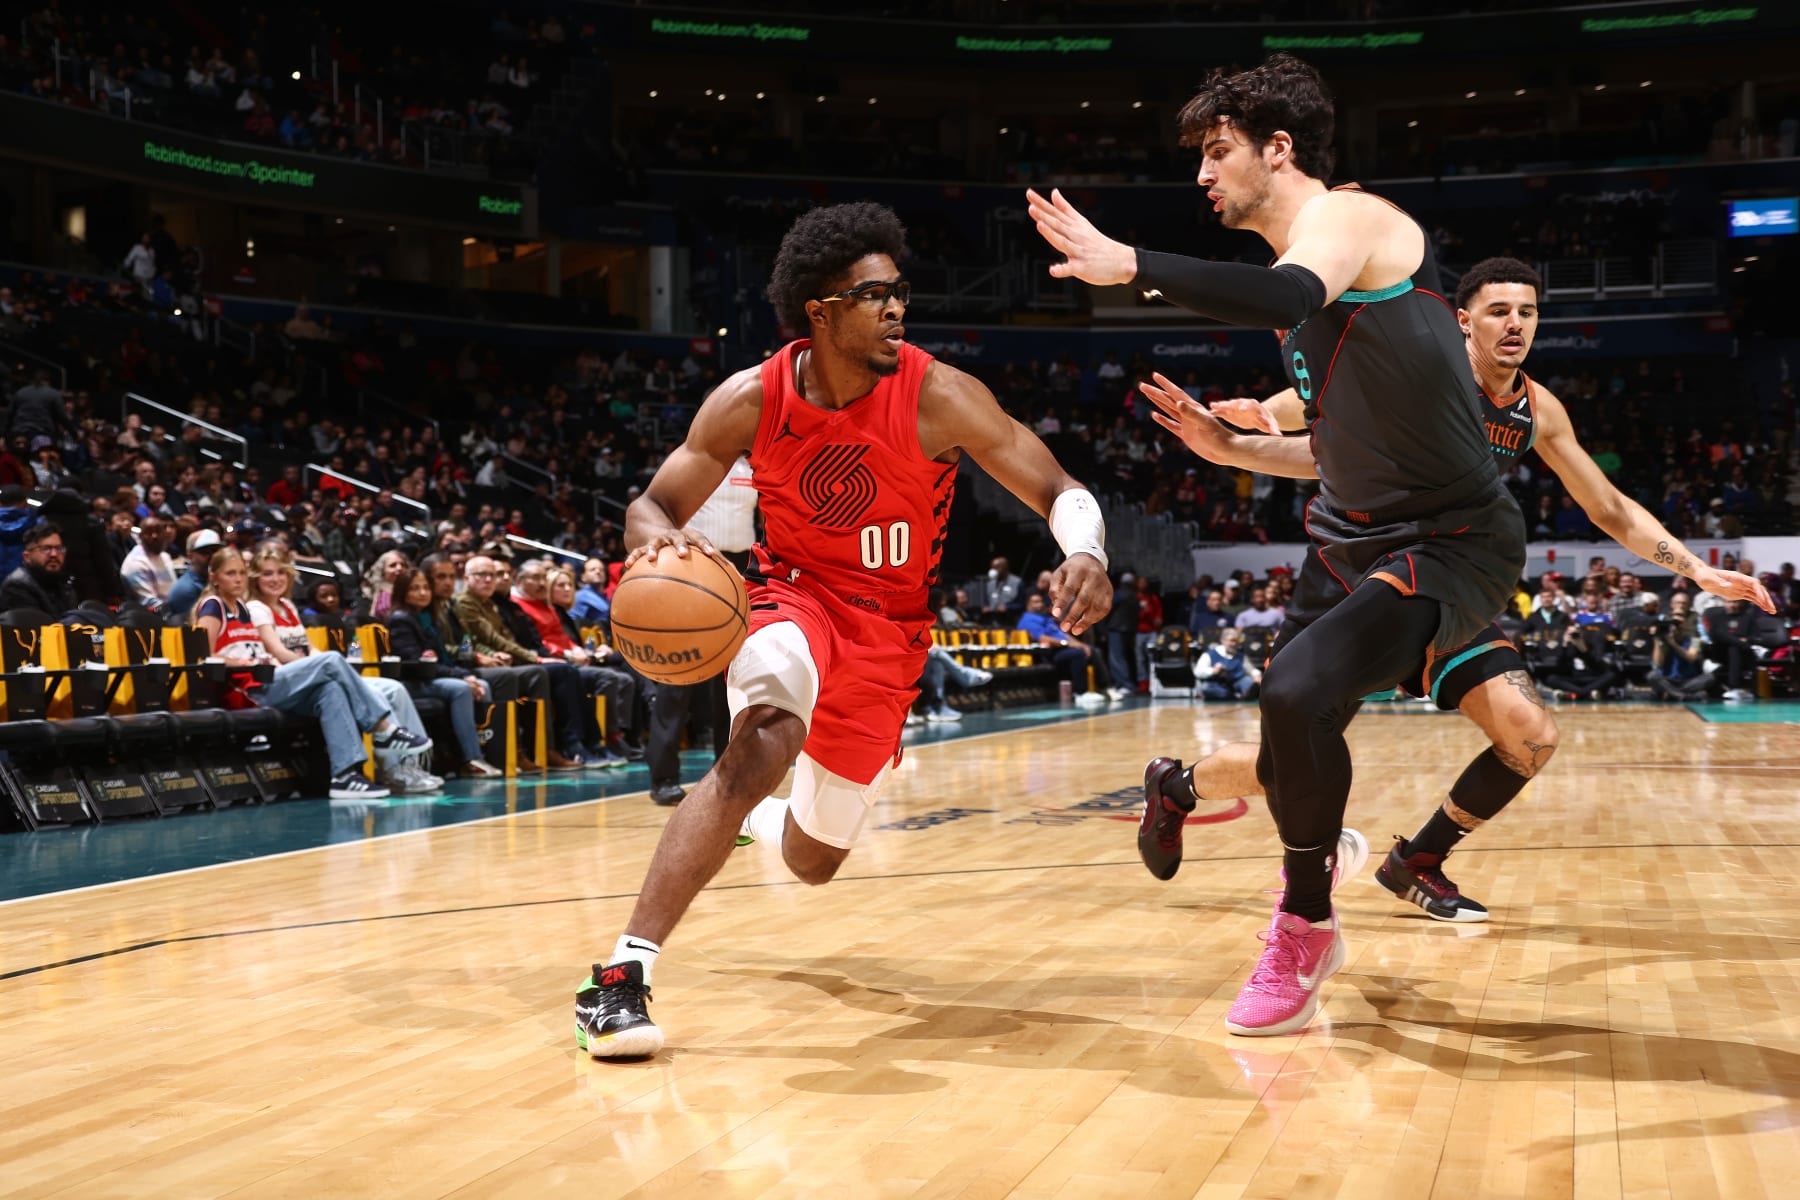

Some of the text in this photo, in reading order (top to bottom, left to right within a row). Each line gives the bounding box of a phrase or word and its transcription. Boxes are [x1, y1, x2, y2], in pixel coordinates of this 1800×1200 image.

[143, 140, 317, 188] Robinhood.com/3pointer
[860, 520, 911, 571] 00
[849, 593, 881, 612] ripcity
[616, 632, 704, 666] Wilson
